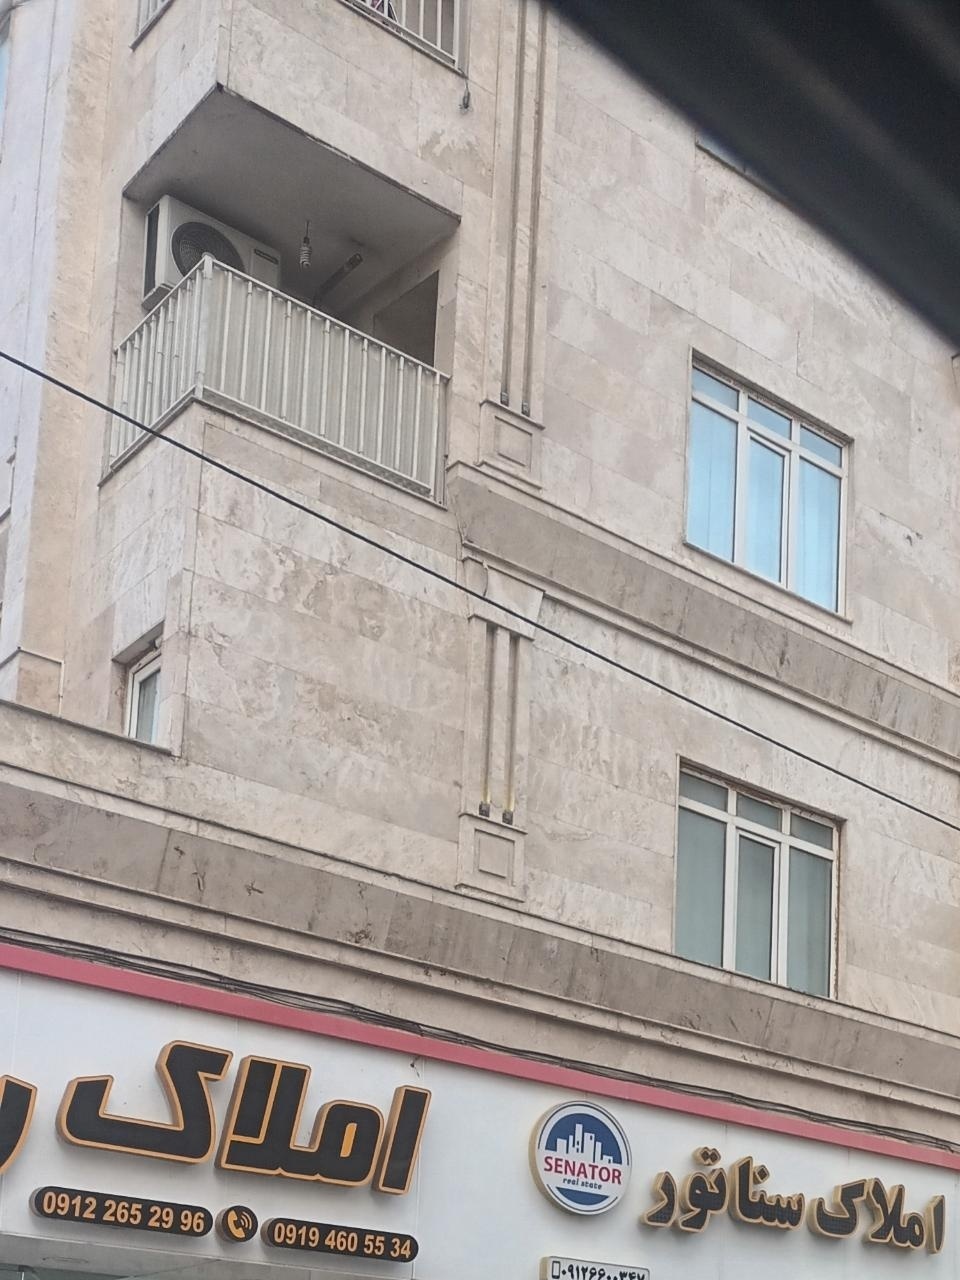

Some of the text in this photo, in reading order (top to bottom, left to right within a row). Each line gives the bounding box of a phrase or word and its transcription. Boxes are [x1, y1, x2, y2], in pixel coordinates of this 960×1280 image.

[56, 1040, 432, 1195] املاک
[543, 1156, 622, 1185] SENATOR
[562, 1177, 603, 1190] real state
[43, 1191, 205, 1233] 0912 265 29 96
[640, 1146, 946, 1254] املاک سناتور
[273, 1222, 411, 1259] 0919 460 55 34
